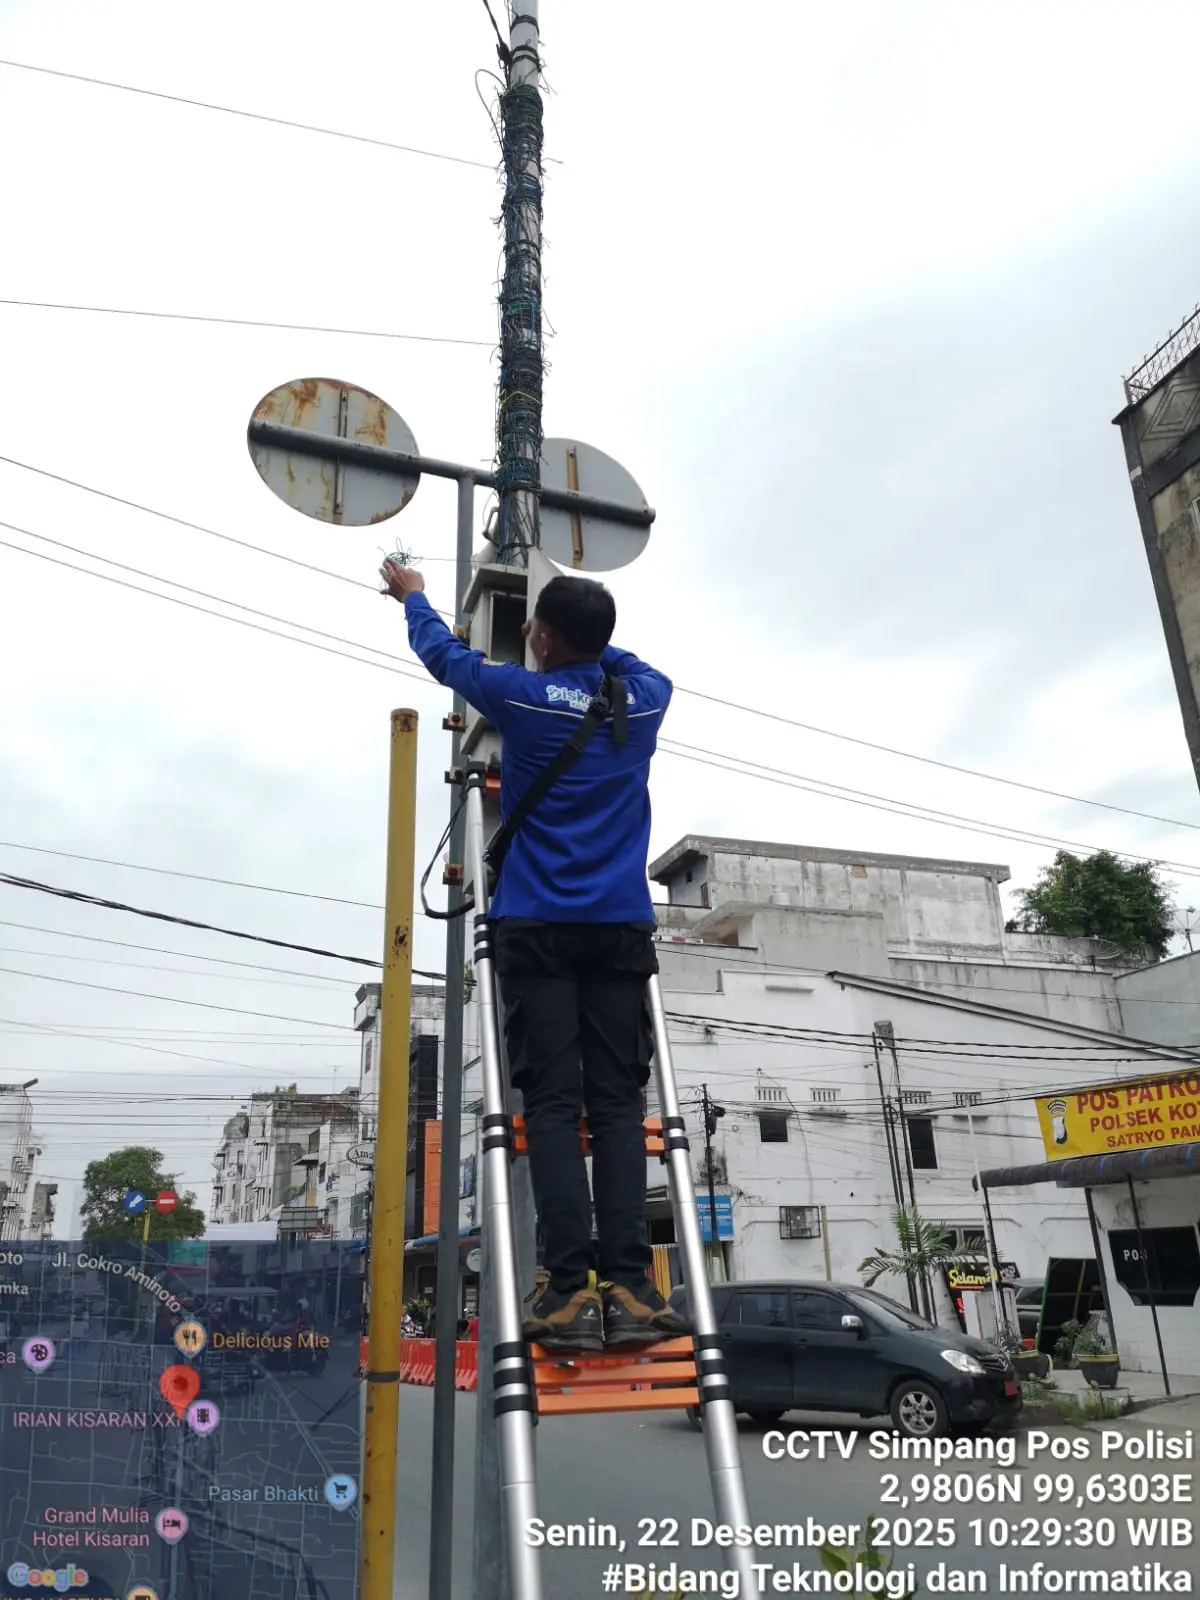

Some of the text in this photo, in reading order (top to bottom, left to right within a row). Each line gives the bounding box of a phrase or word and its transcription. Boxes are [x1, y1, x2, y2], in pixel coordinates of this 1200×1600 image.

[1077, 1090, 1119, 1114] POS
[1090, 1107, 1163, 1133] POLSEK
[1107, 1129, 1165, 1147] SATRYO
